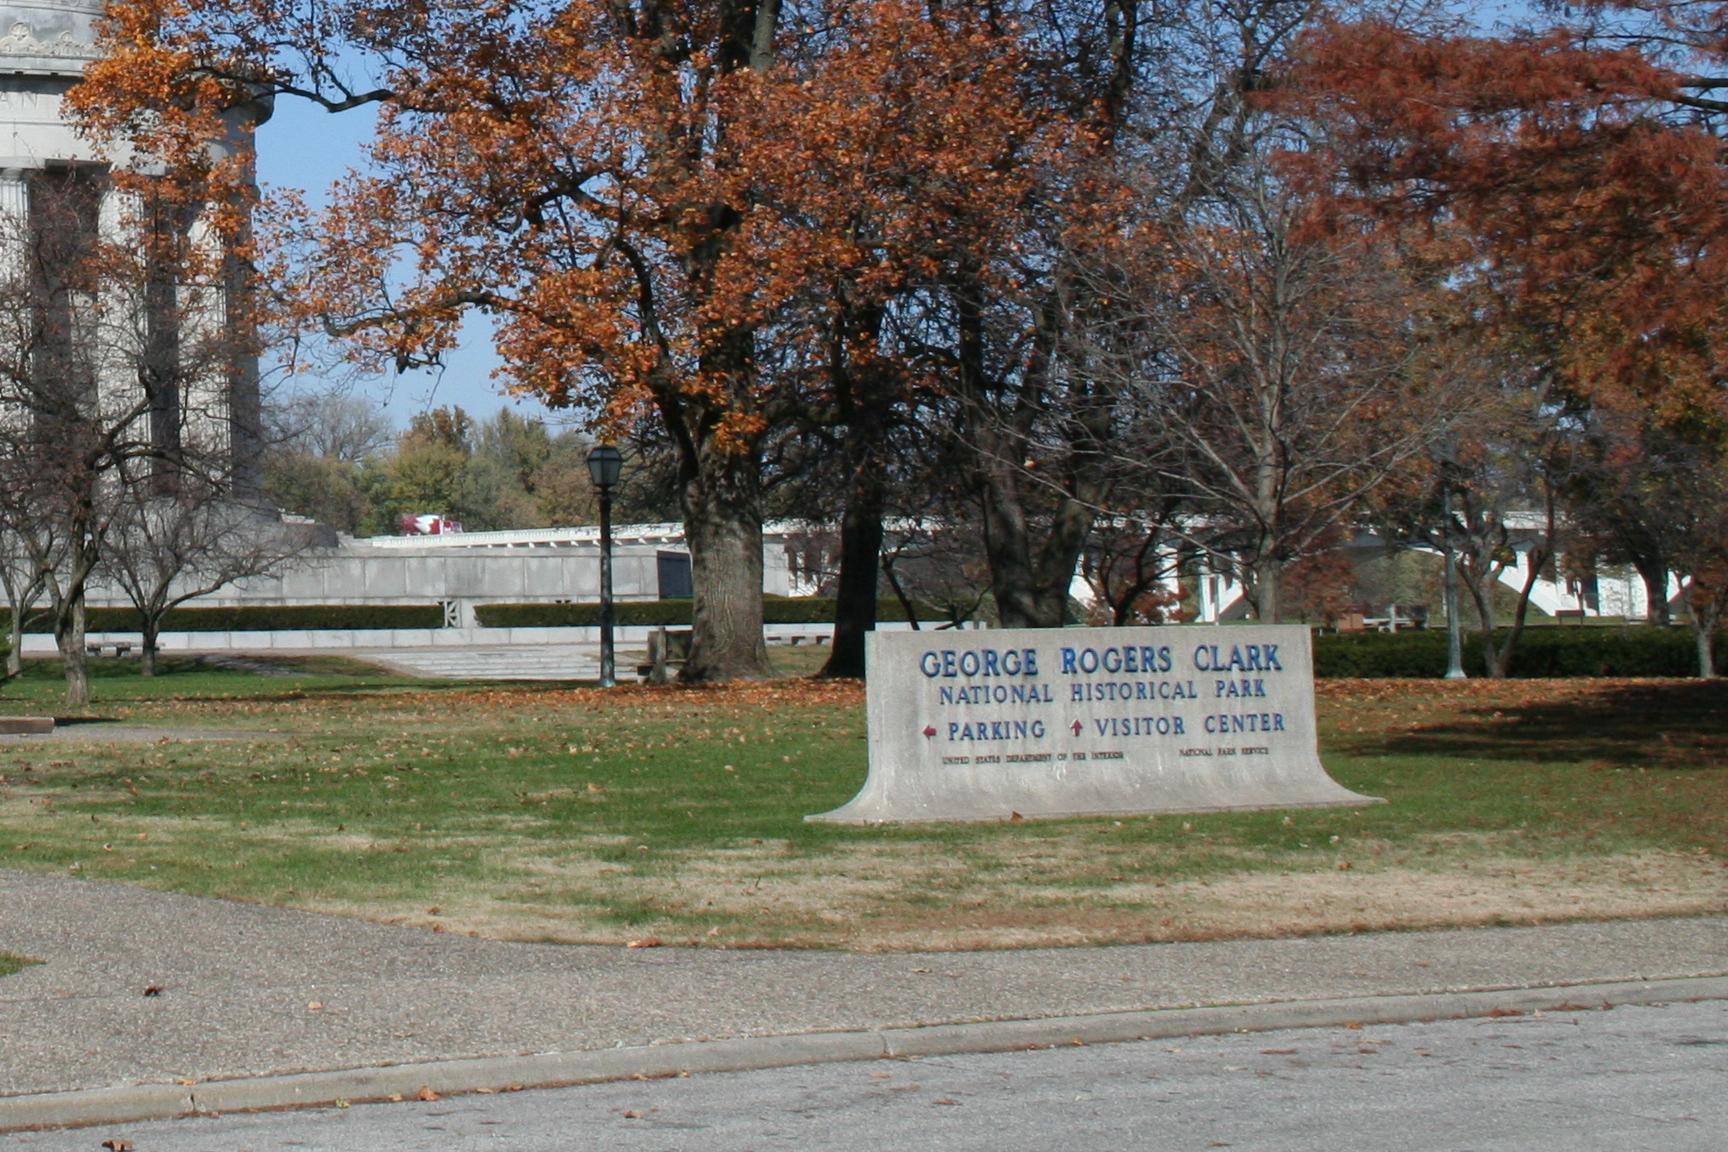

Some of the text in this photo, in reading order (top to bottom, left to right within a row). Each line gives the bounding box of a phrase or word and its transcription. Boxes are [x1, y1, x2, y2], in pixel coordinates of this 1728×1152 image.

[920, 644, 1283, 679] GEORGE ROGERS CLARK
[939, 678, 1267, 706] NATIONAL HISTORICAL PARK
[948, 720, 1046, 741] PARKING
[1095, 713, 1286, 737] VISITOR CENTER
[942, 756, 970, 765] UNITED
[975, 755, 1001, 764] STATES
[1006, 753, 1052, 763] DEPARTMENT
[1058, 752, 1068, 761] OF
